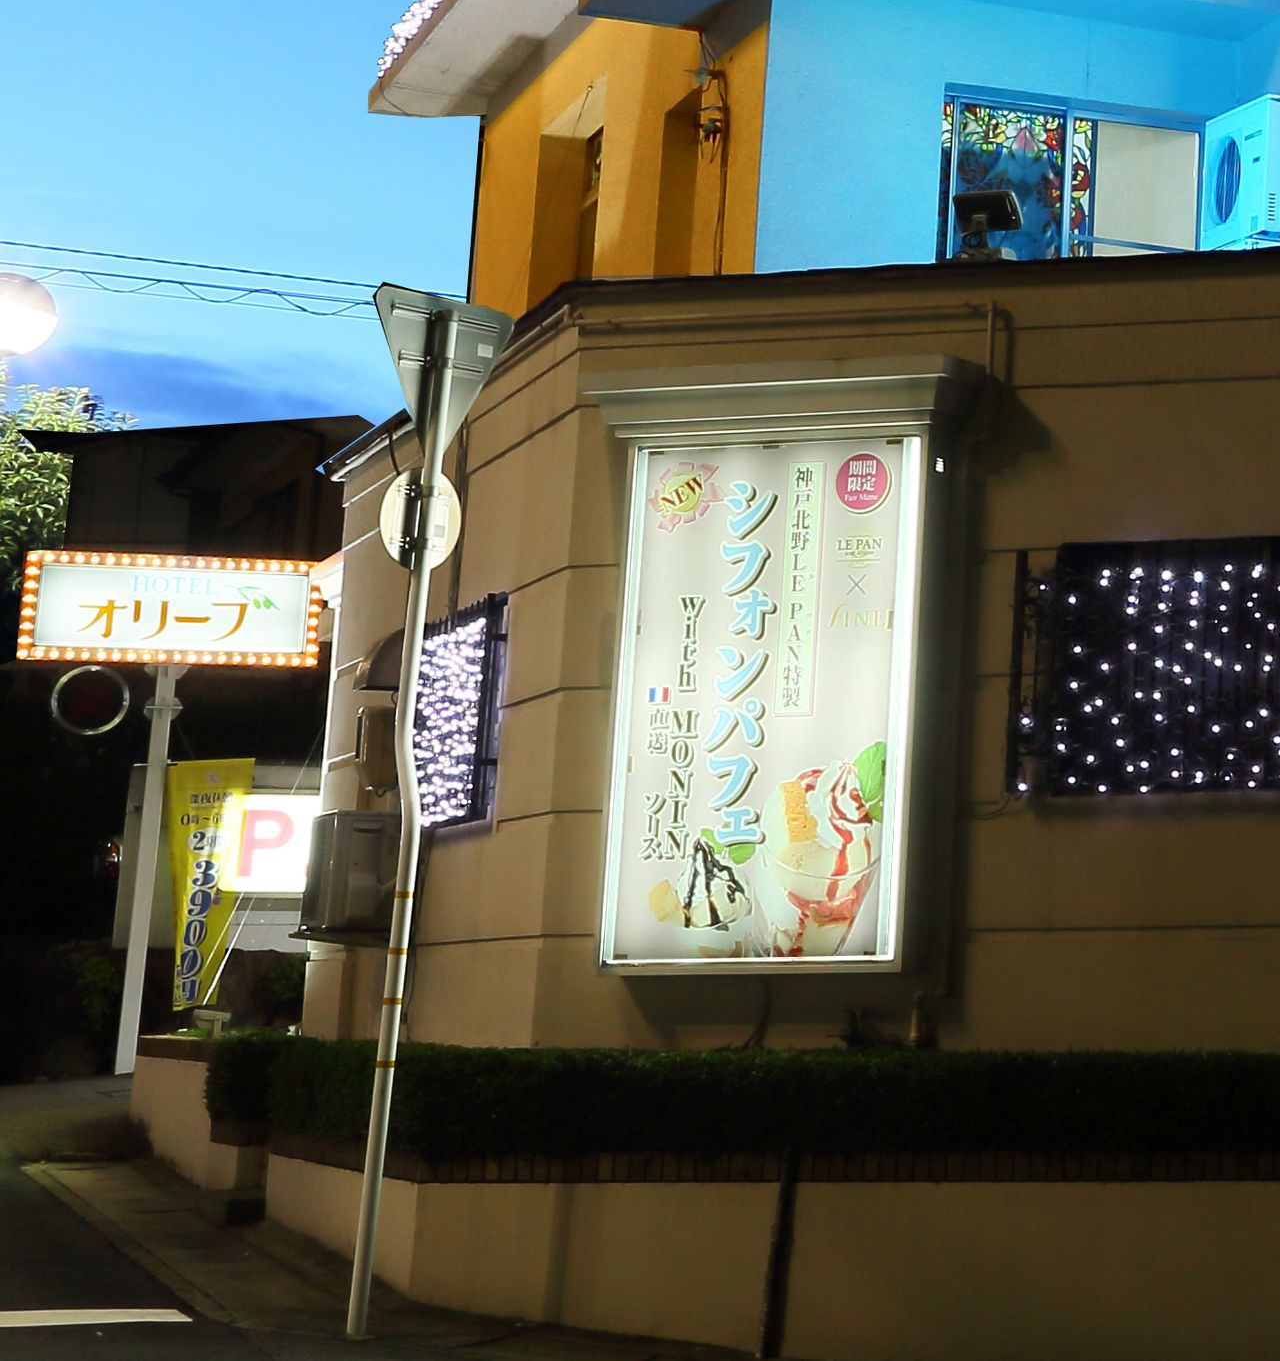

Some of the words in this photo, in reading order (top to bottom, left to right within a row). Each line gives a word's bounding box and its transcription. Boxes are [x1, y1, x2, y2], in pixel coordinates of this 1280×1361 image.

[847, 476, 876, 492] 限定
[848, 459, 877, 476] 期間
[660, 473, 704, 514] NEW
[837, 538, 853, 551] LE
[855, 537, 883, 550] PAN
[131, 574, 219, 596] HOTEL
[702, 480, 778, 846] シフォンパフェ
[647, 708, 670, 754] 直送
[663, 709, 700, 859] MONIN
[237, 809, 295, 878] P
[640, 792, 667, 860] ソース
